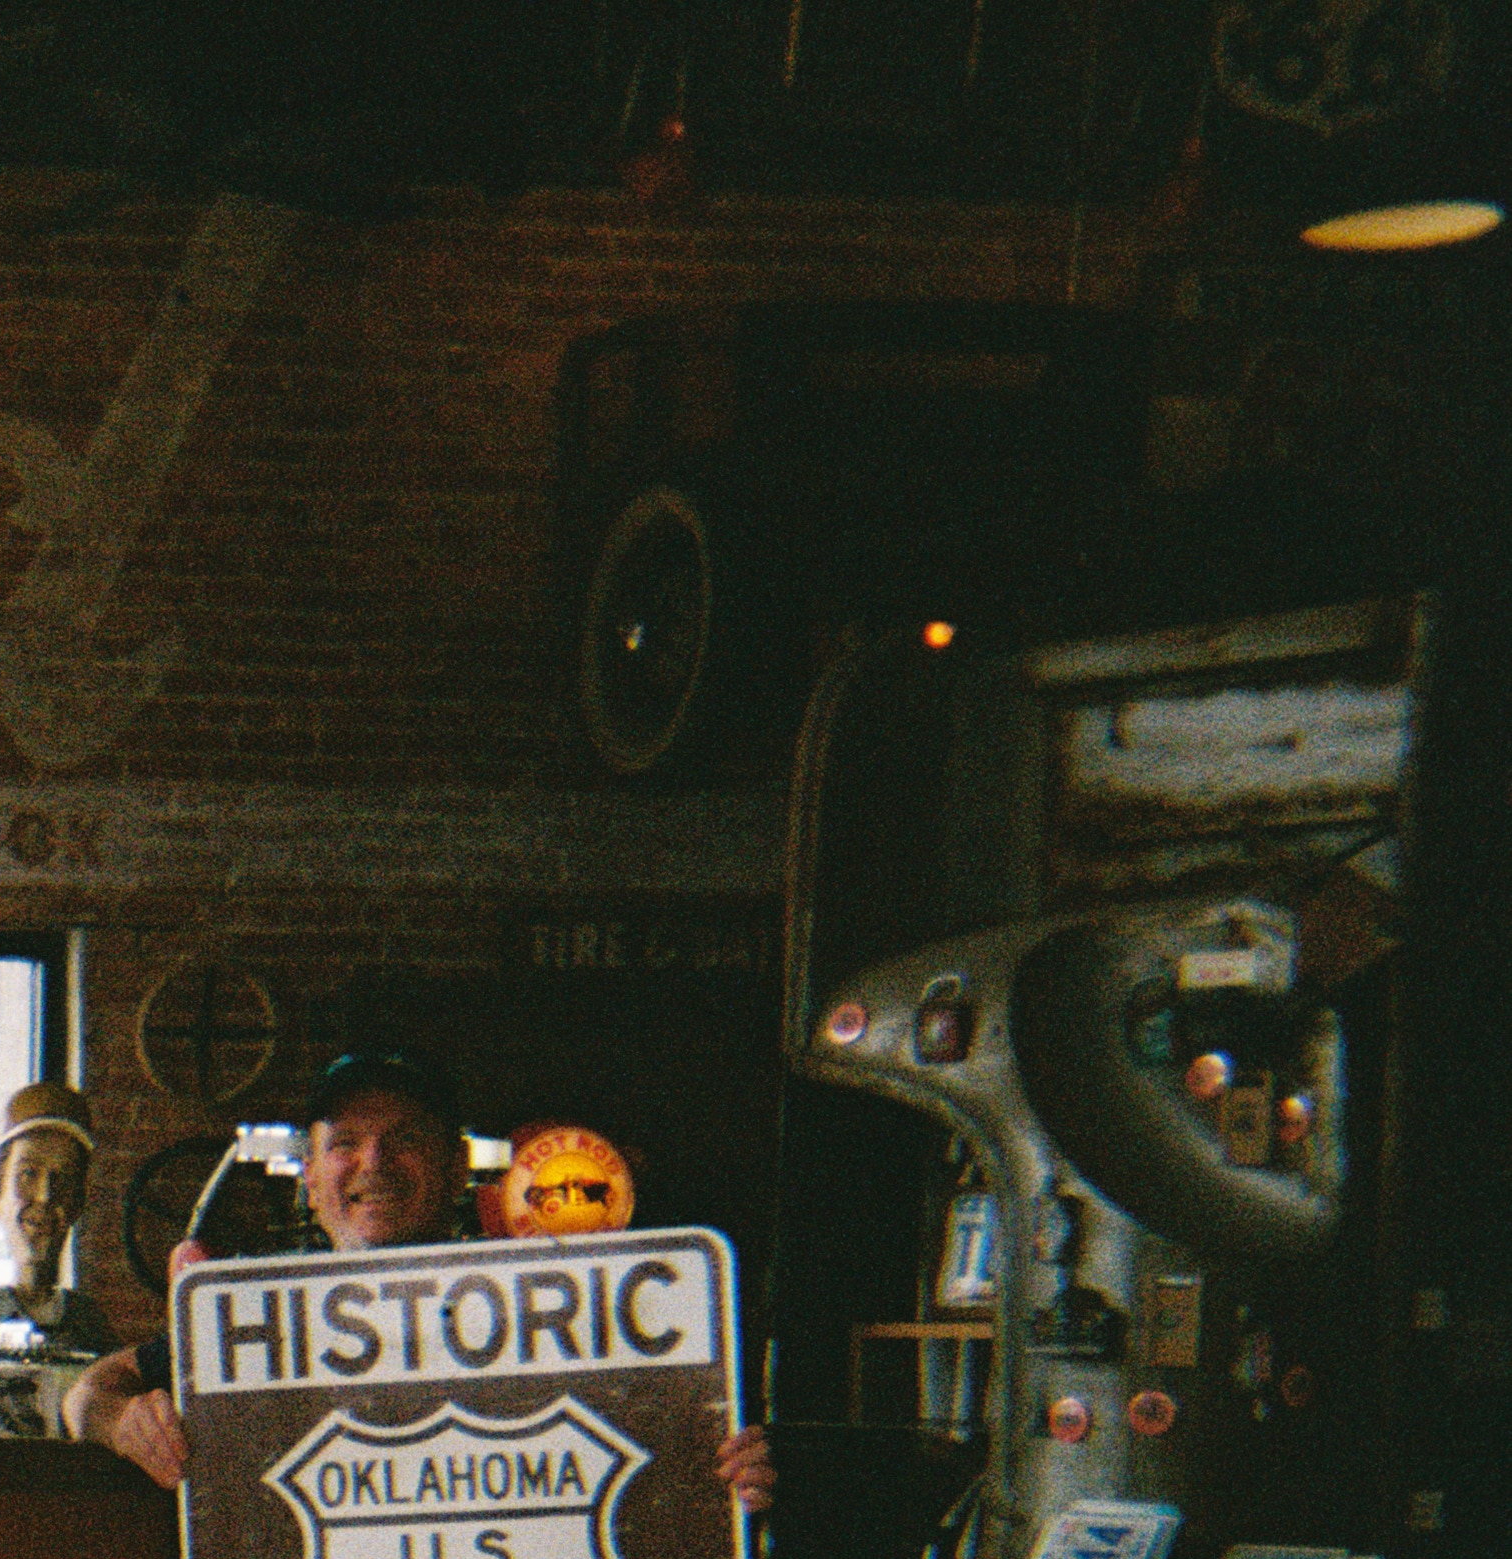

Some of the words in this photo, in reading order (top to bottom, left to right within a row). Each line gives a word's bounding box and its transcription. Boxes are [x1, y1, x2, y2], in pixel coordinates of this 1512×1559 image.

[519, 1133, 570, 1173] HOT
[577, 1133, 621, 1175] ROD
[215, 1260, 683, 1384] HISTORIC
[315, 1447, 590, 1510] OKLAHOMA
